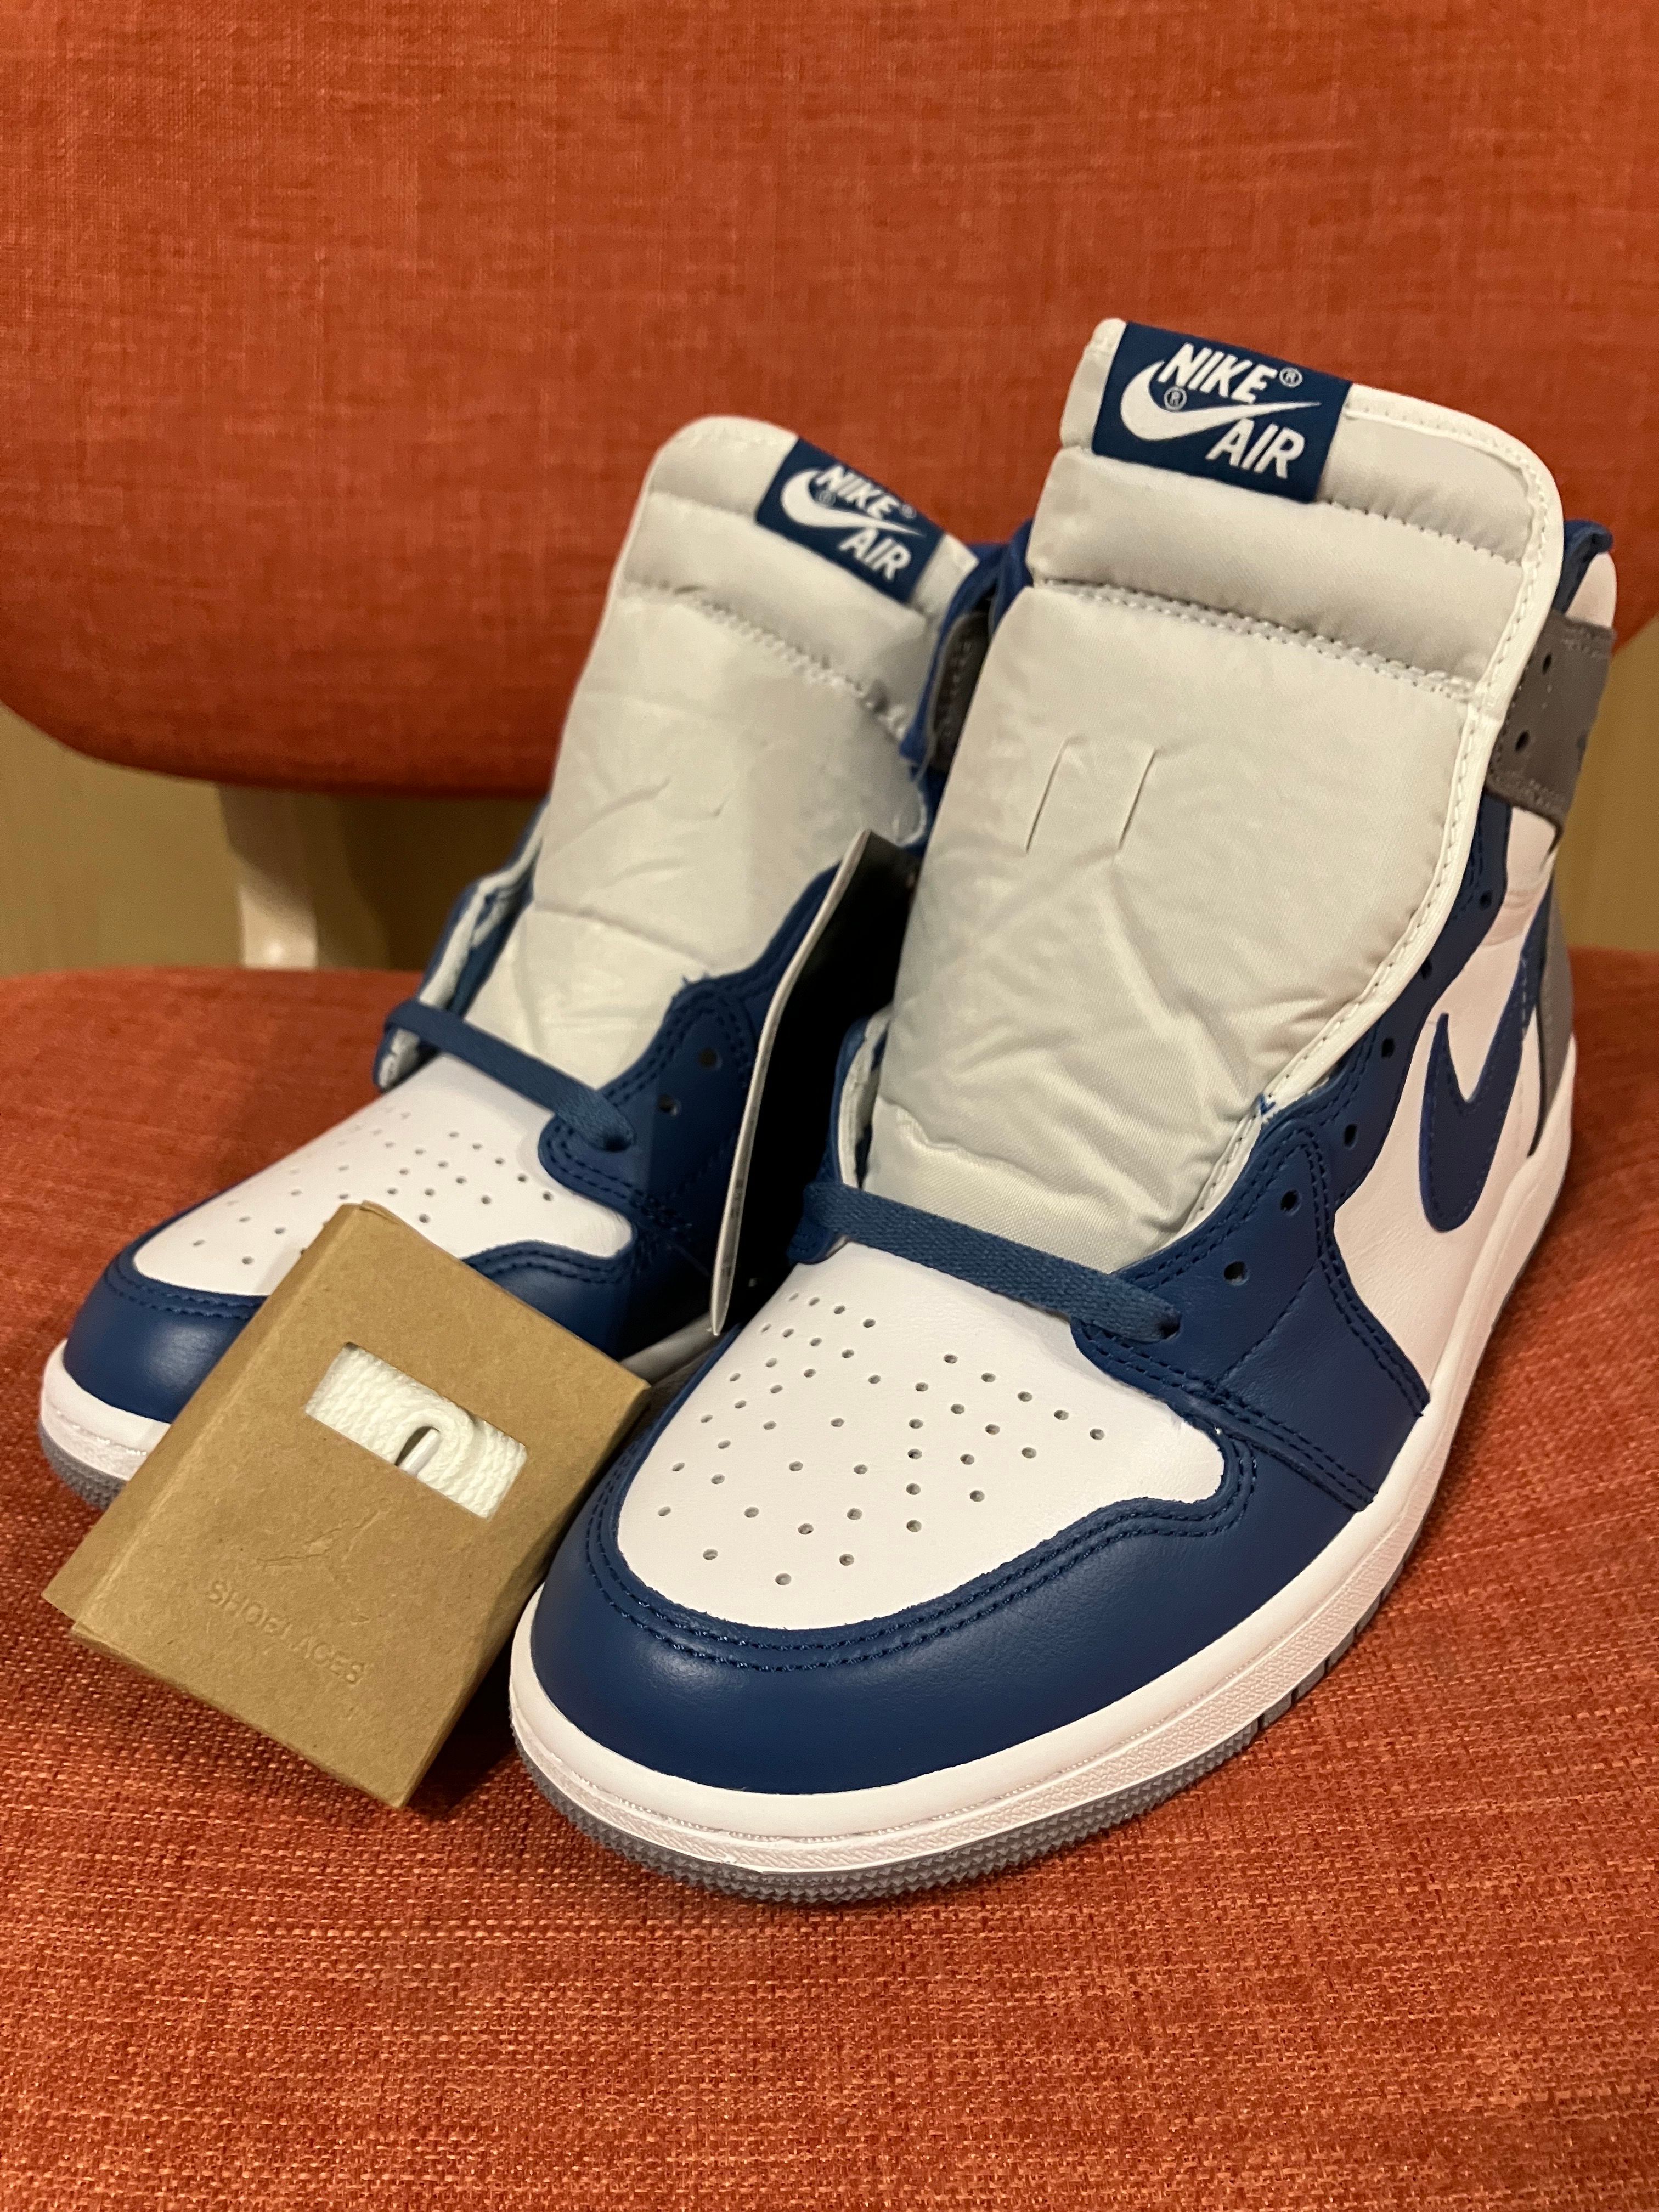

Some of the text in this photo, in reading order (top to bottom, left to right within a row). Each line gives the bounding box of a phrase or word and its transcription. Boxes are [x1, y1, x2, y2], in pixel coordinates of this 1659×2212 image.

[1205, 417, 1306, 479] AIR
[838, 527, 911, 582] AIR
[207, 1580, 366, 1685] SHOELACES
